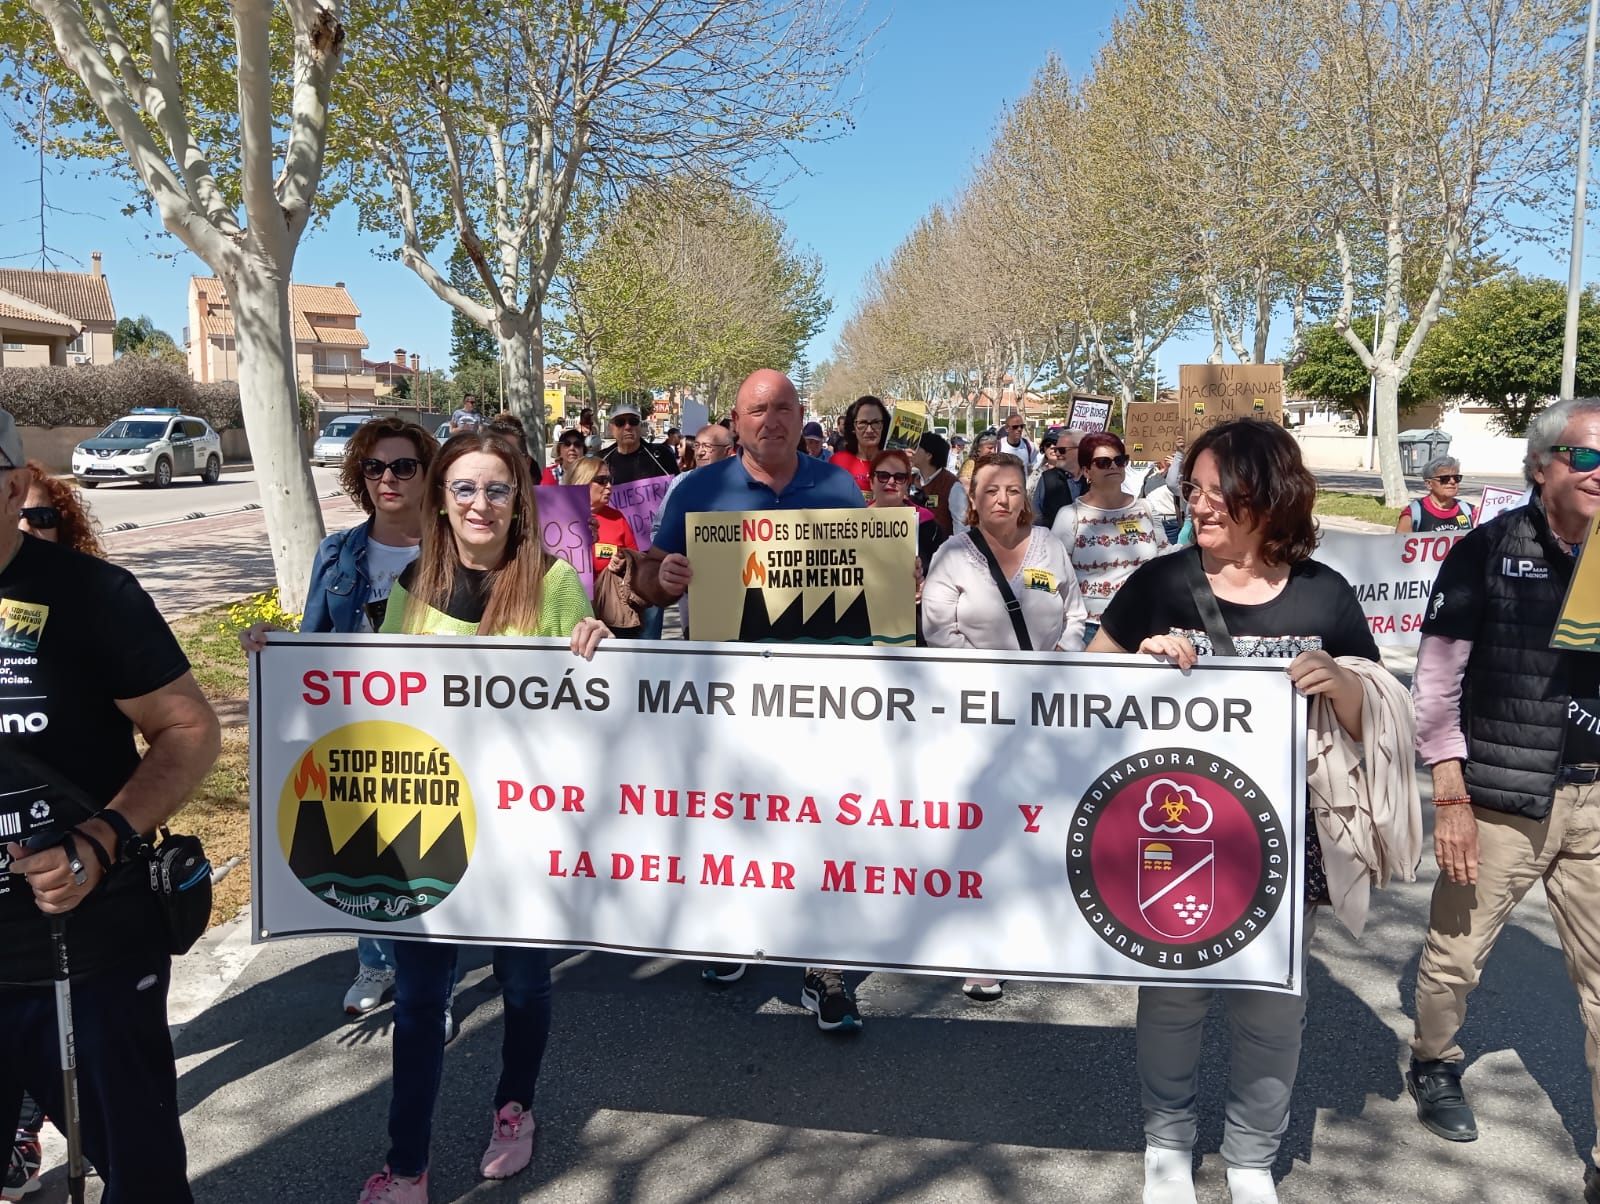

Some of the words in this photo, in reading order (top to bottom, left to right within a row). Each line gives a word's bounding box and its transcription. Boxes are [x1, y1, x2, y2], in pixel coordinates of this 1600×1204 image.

[1219, 367, 1234, 381] NI
[1180, 381, 1282, 399] MACROGRANJAS
[1131, 412, 1148, 424] NO
[1221, 399, 1234, 411] NI
[695, 525, 740, 542] PORQUE
[742, 519, 773, 542] NO
[775, 524, 789, 541] ES
[795, 523, 809, 540] DE
[813, 518, 857, 540] INTERÉS
[861, 517, 908, 539] PÚBLICO
[768, 550, 803, 567] STOP
[1401, 535, 1465, 563] STO
[768, 569, 803, 588] MAR
[806, 567, 864, 588] MENOR
[1502, 557, 1533, 577] ILP
[3, 656, 38, 667] puede
[302, 670, 427, 706] STOP
[443, 668, 610, 712] BIOGÁS
[637, 679, 735, 716] MAR
[752, 683, 916, 722] MENOR
[960, 690, 1016, 726] EL
[1031, 692, 1253, 733] MIRADOR
[0, 712, 49, 733] no
[329, 750, 377, 773] STOP
[381, 747, 450, 776] BIOGÁS
[329, 776, 377, 803] MAR
[381, 777, 459, 806] MENOR
[1209, 761, 1257, 800] STOP
[497, 780, 585, 812] POR
[619, 783, 822, 824] NUESTRA
[835, 792, 983, 830] SALUD
[1018, 804, 1043, 833] Y
[1071, 753, 1196, 858] COORDINADORA
[1258, 811, 1282, 896] BIOGÁS
[548, 850, 597, 878] LA
[610, 853, 686, 884] DEL
[700, 853, 796, 890] MAR
[820, 860, 983, 899] MENOR
[1079, 889, 1144, 957] MURCIA
[1197, 906, 1267, 962] REGIÓN
[1158, 951, 1183, 964] DE
